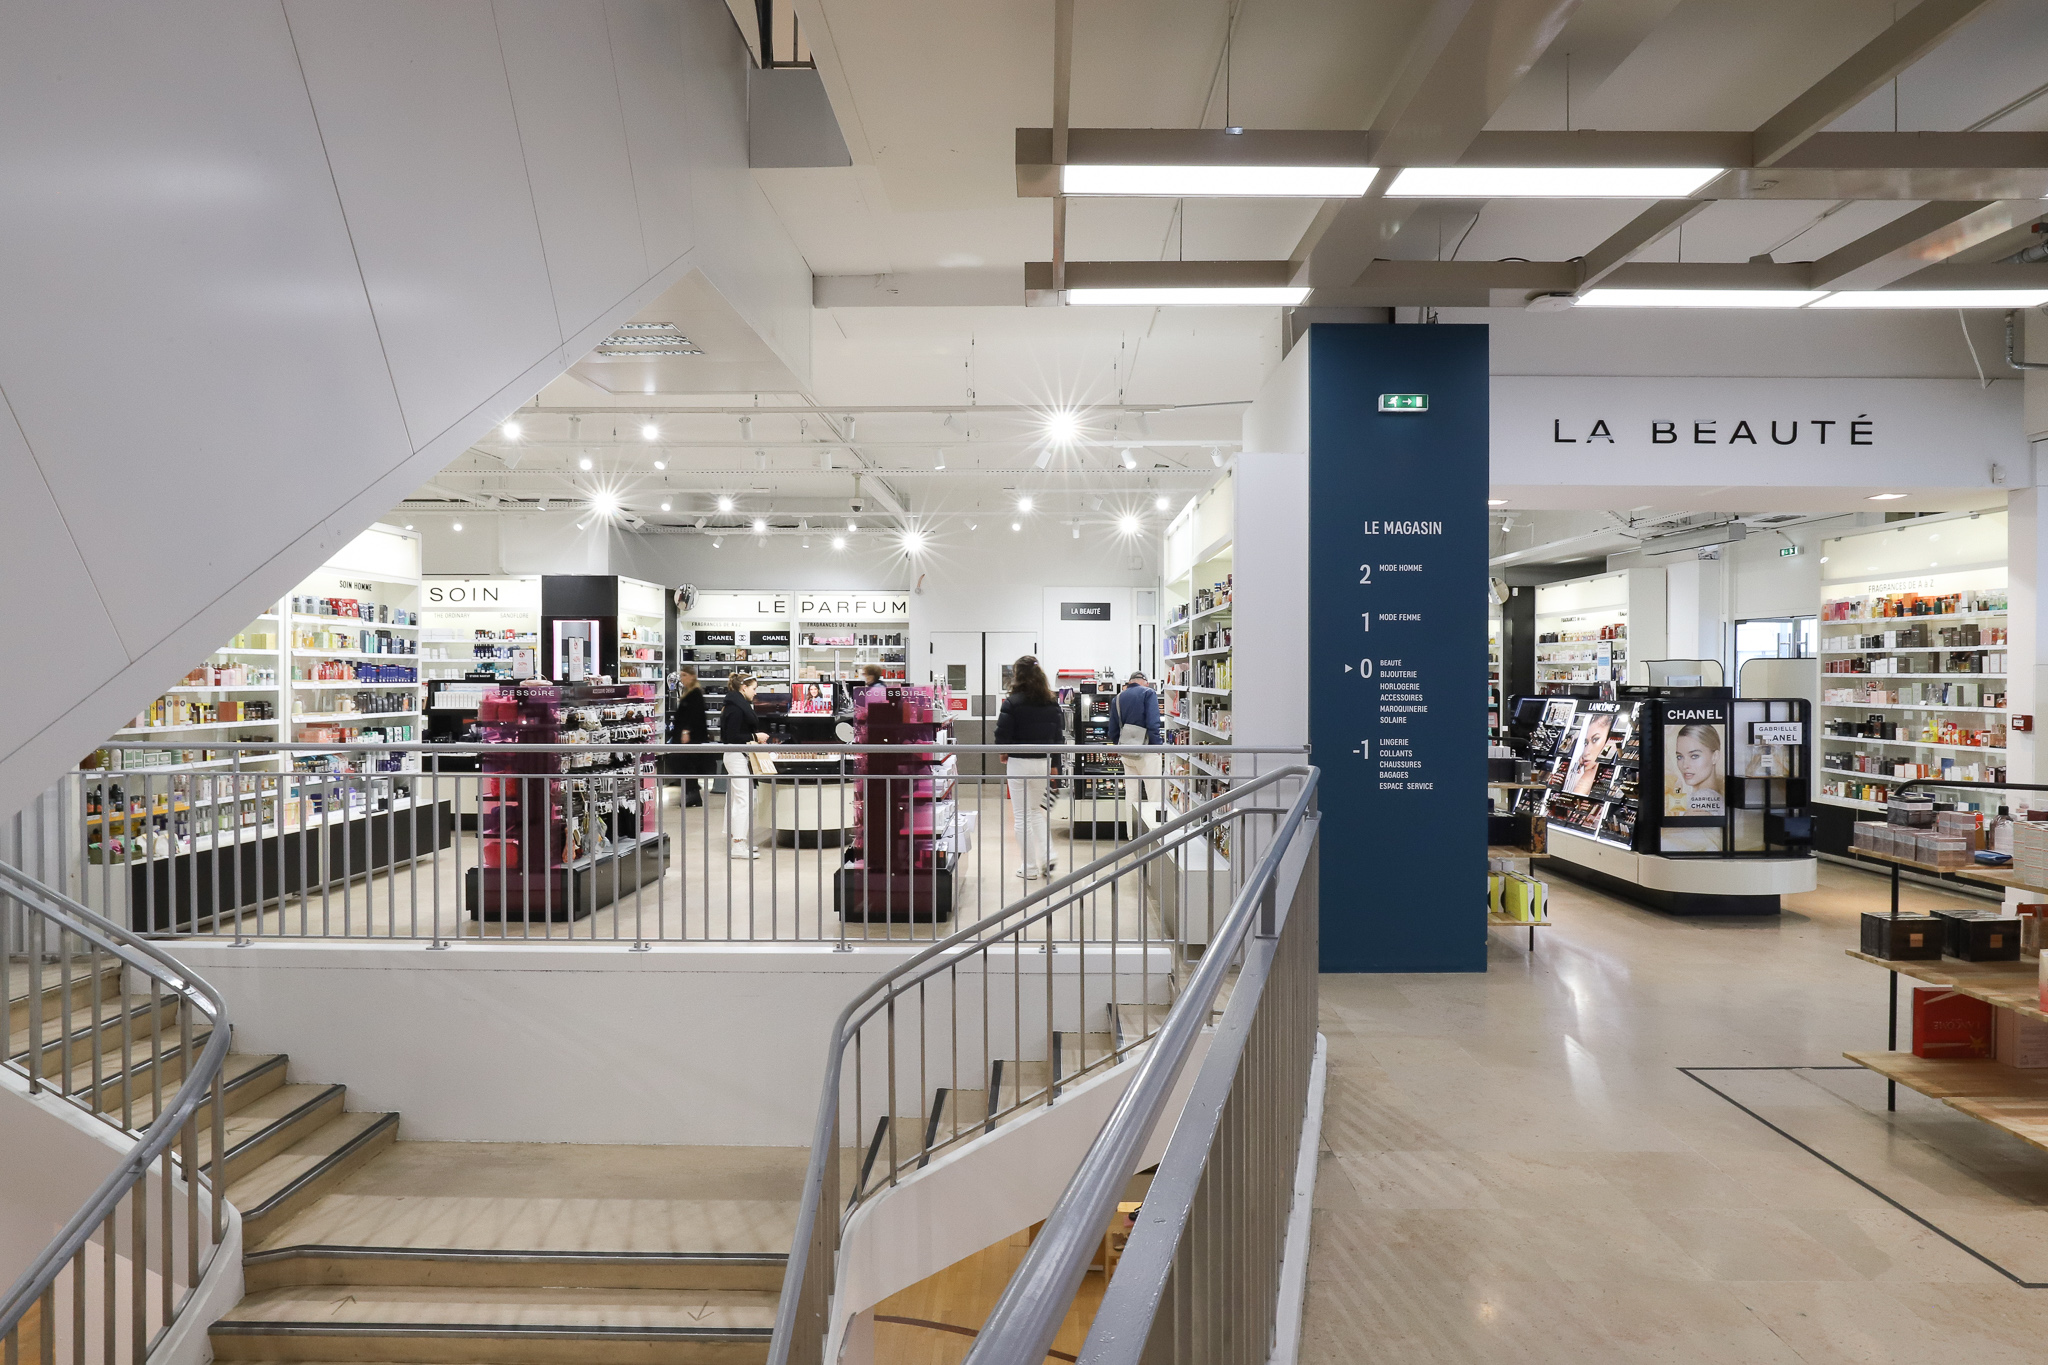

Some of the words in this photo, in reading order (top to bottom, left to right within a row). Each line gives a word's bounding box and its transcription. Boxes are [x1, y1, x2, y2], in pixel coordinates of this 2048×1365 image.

[1554, 419, 1615, 444] LA
[1652, 414, 1873, 445] BEAUTÉ
[1364, 521, 1379, 535] LE
[1384, 521, 1442, 535] MAGASIN
[1359, 564, 1372, 584] 2
[1379, 564, 1397, 572] MODE
[1399, 564, 1423, 572] HOMME
[339, 580, 353, 589] SOIN
[354, 582, 372, 592] HOMME
[1868, 581, 1907, 593] FRAGRANCES
[1908, 580, 1916, 589] DE
[1918, 580, 1923, 588] A
[429, 587, 499, 602] SOIN
[758, 601, 786, 613] LE
[802, 601, 906, 614] PARFUM
[1079, 607, 1101, 615] BEAUTÉ
[1361, 612, 1369, 632] 1
[1378, 613, 1397, 621] MODE
[1399, 613, 1421, 621] FEMME
[1360, 658, 1373, 679] 0
[1380, 683, 1420, 691] HORLOGERIE
[1380, 705, 1428, 713] MAROQUINERIE
[1667, 709, 1723, 720] CHANEL
[1769, 734, 1798, 742] ANEL
[1352, 739, 1369, 760] -1
